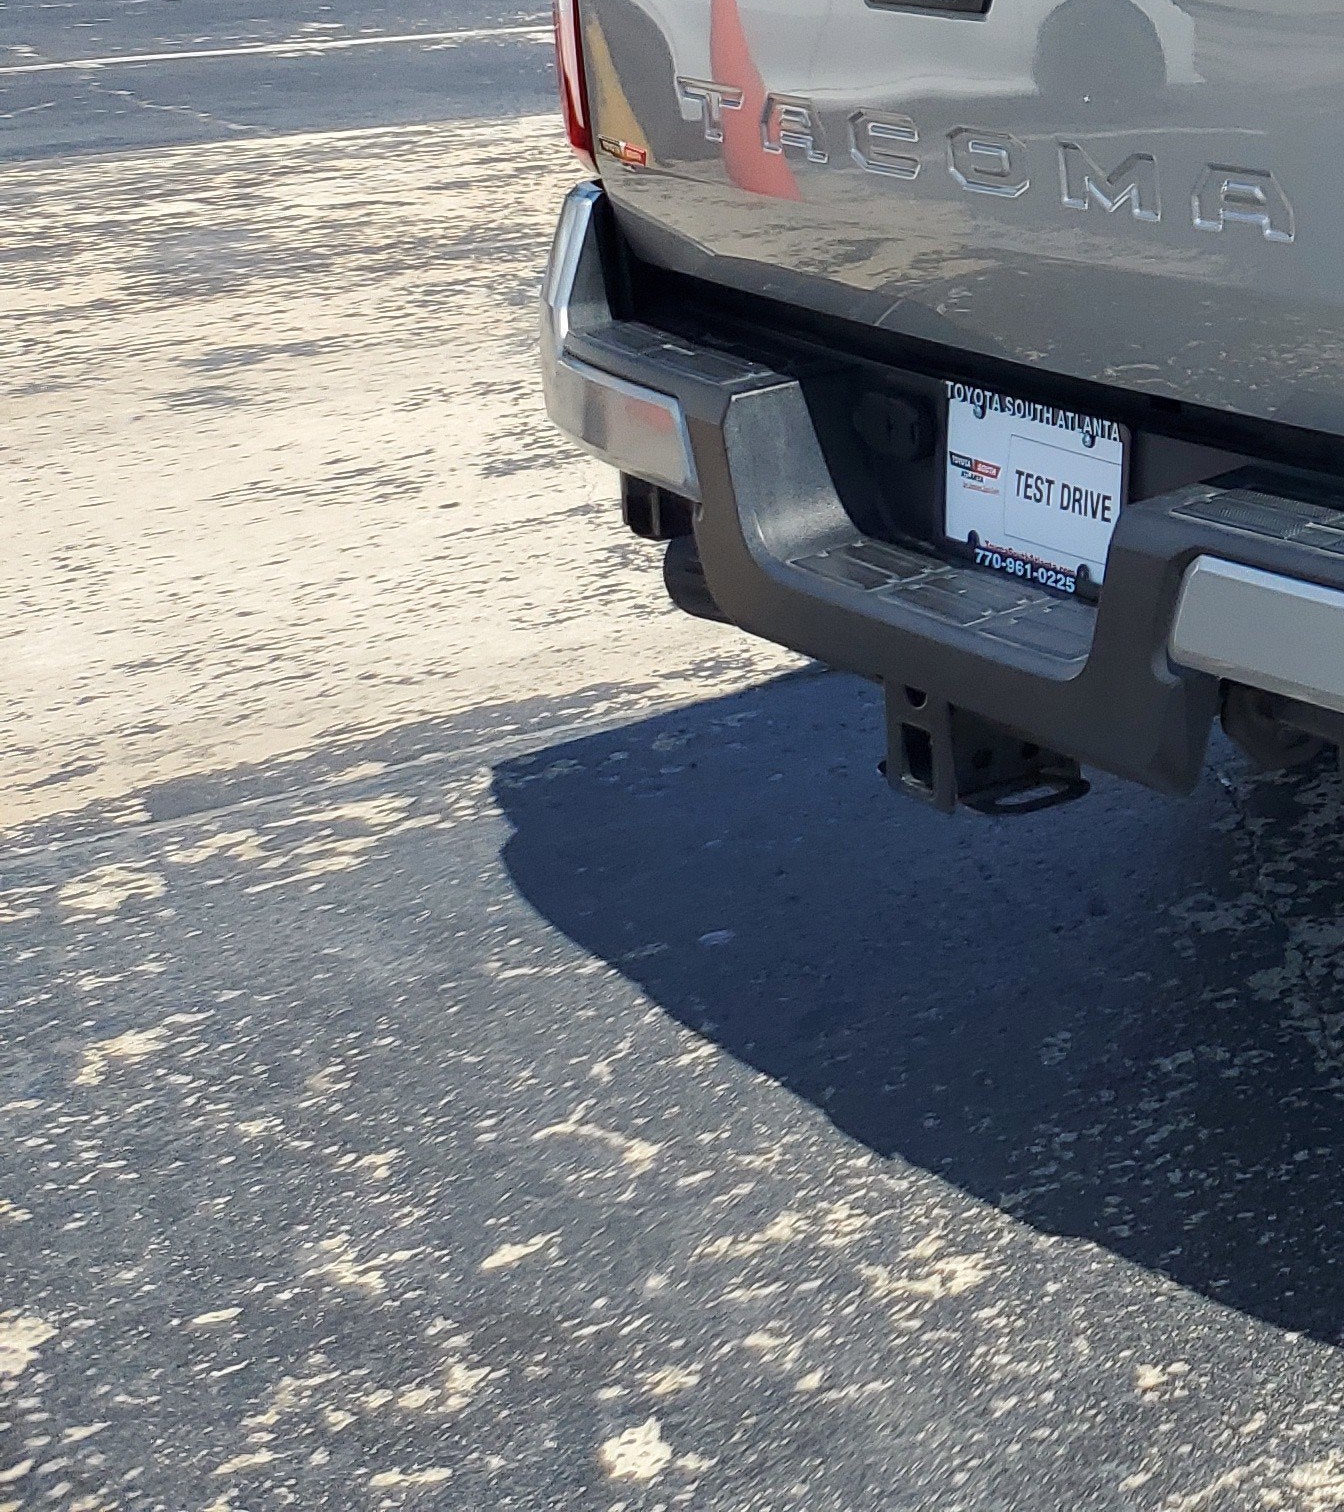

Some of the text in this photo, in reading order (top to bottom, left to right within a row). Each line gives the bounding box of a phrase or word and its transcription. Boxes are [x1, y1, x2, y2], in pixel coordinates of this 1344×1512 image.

[676, 75, 1296, 244] TACOMA
[945, 380, 1121, 442] TOYOTA SOUTH ATLANTA
[1015, 468, 1112, 524] TEST DRIVE
[974, 548, 1077, 594] 770-961-0225
